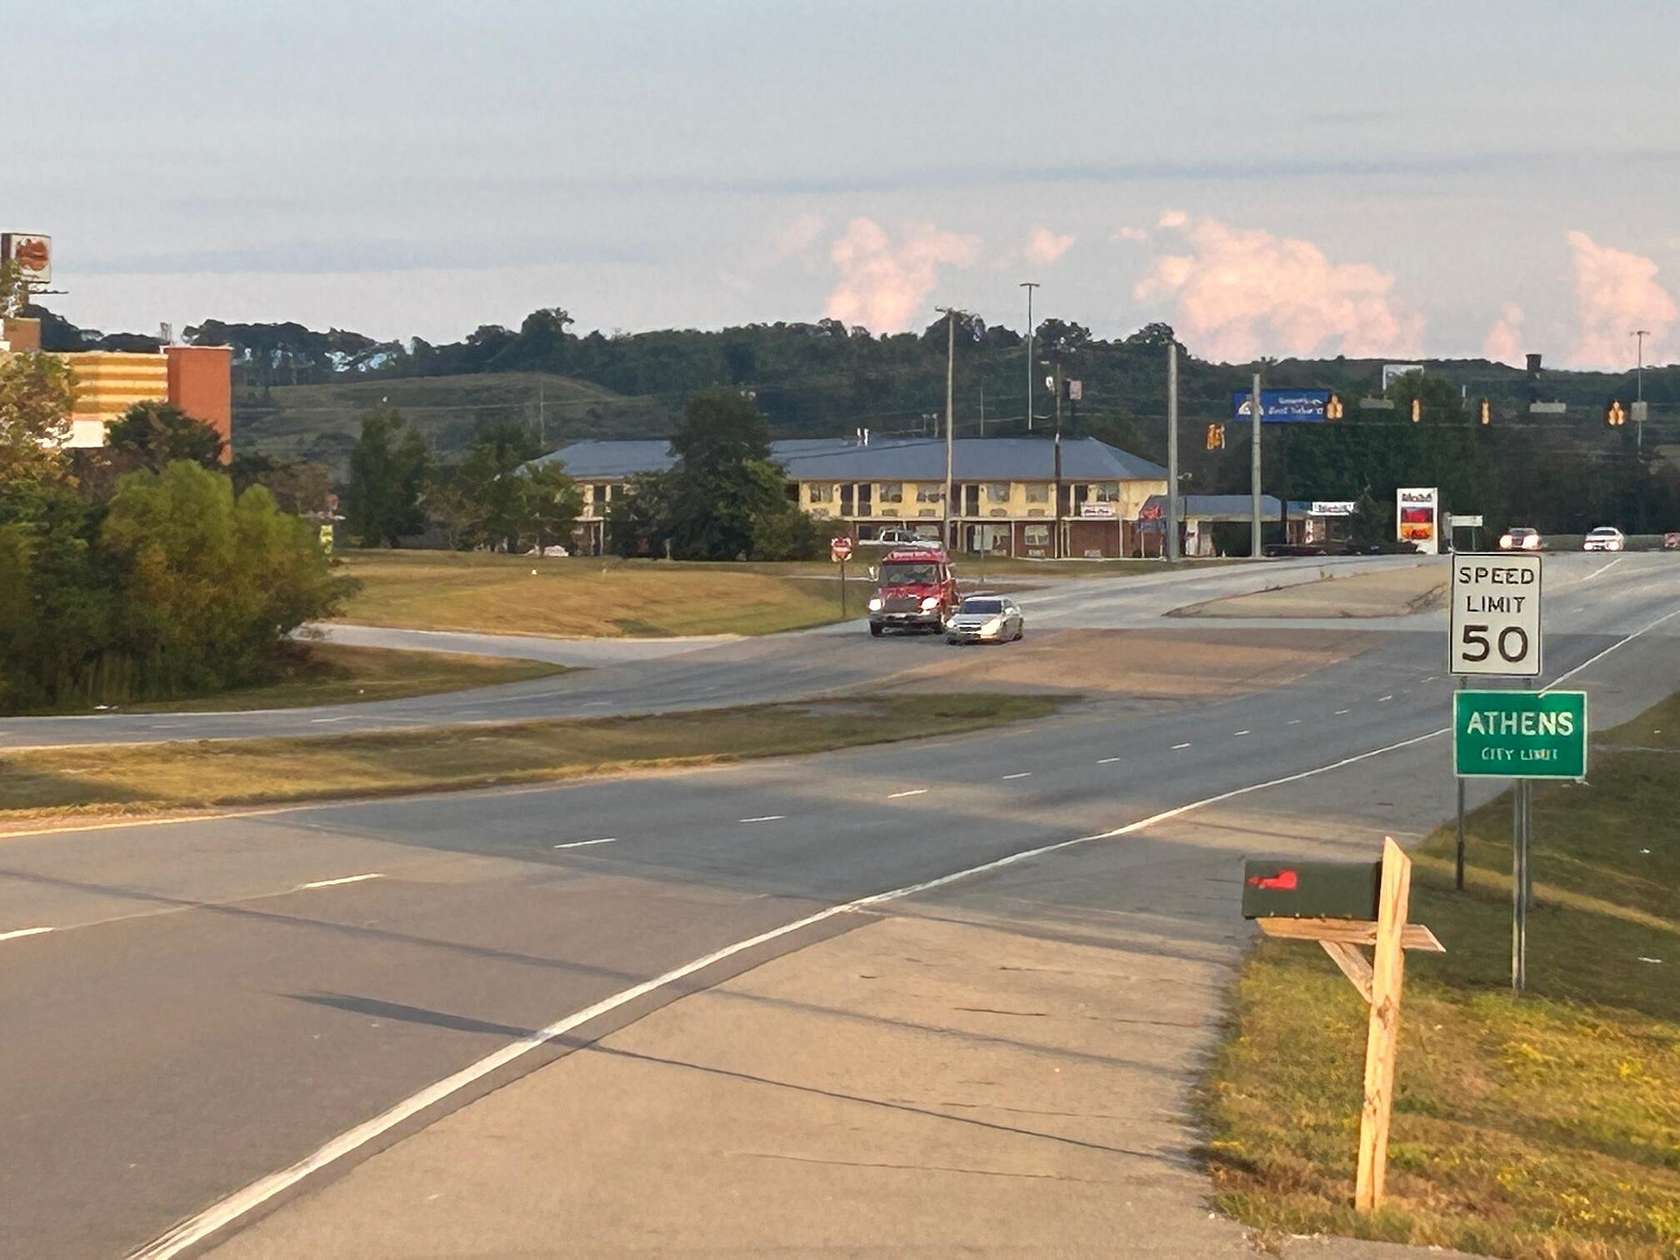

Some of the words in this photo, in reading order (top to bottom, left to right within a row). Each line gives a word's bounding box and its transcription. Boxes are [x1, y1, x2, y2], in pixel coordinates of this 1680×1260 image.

[1459, 567, 1534, 585] SPEED
[1467, 596, 1526, 613] LIMIT
[1462, 625, 1528, 663] 50
[1467, 711, 1574, 736] ATHENS
[1481, 747, 1514, 760] CITY
